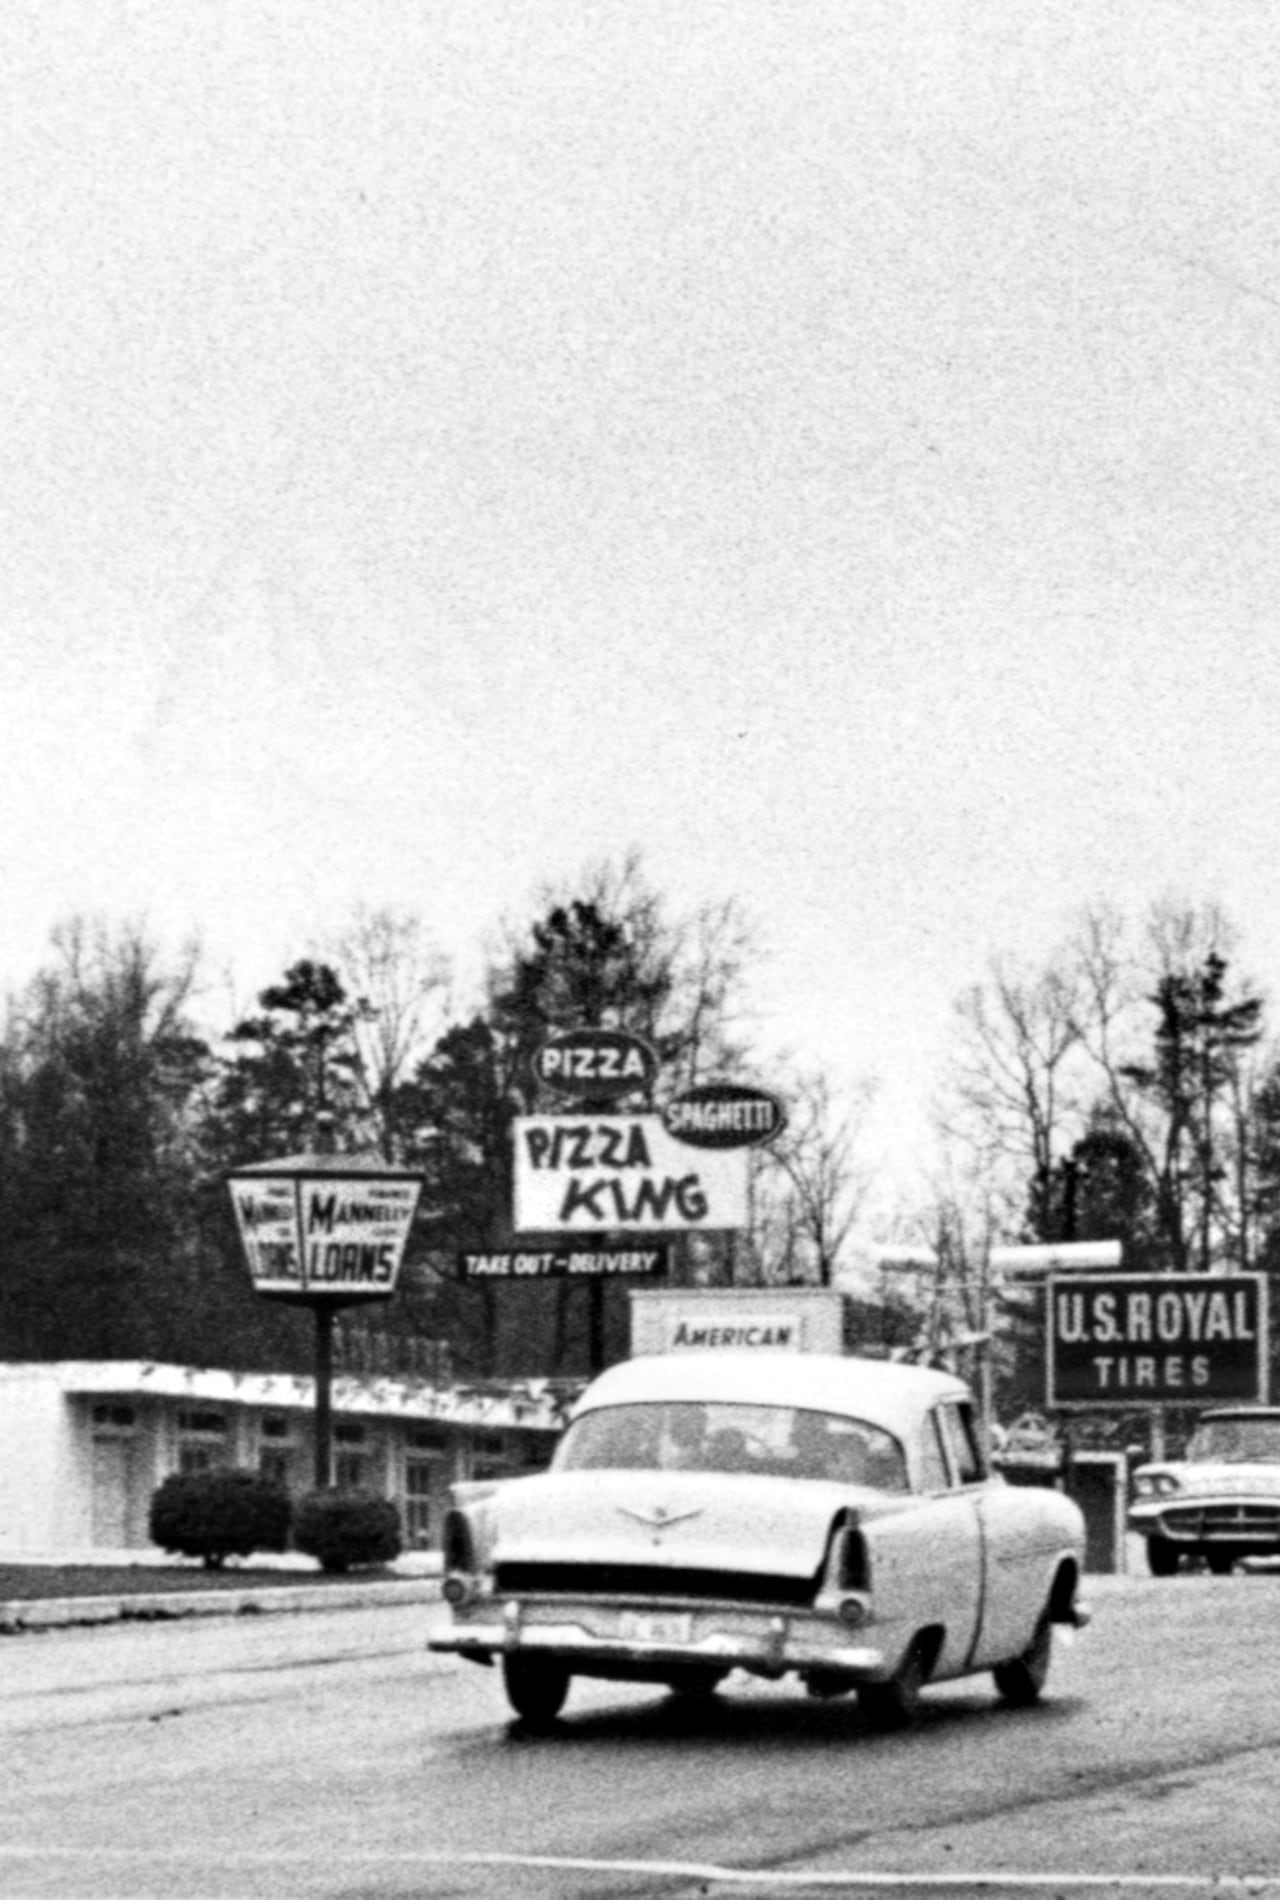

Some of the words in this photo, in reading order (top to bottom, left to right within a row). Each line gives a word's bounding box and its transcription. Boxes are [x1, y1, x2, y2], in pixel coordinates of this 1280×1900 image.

[542, 1048, 644, 1078] PIZZA
[663, 1096, 772, 1132] SPAGHETTI
[524, 1123, 652, 1171] PIZZA
[559, 1173, 709, 1221] KING
[308, 1242, 394, 1283] LOANS
[467, 1255, 510, 1274] TAKE
[1127, 1291, 1254, 1341] ROYAL
[672, 1322, 792, 1348] AMERICAN
[1094, 1356, 1209, 1388] TIRES
